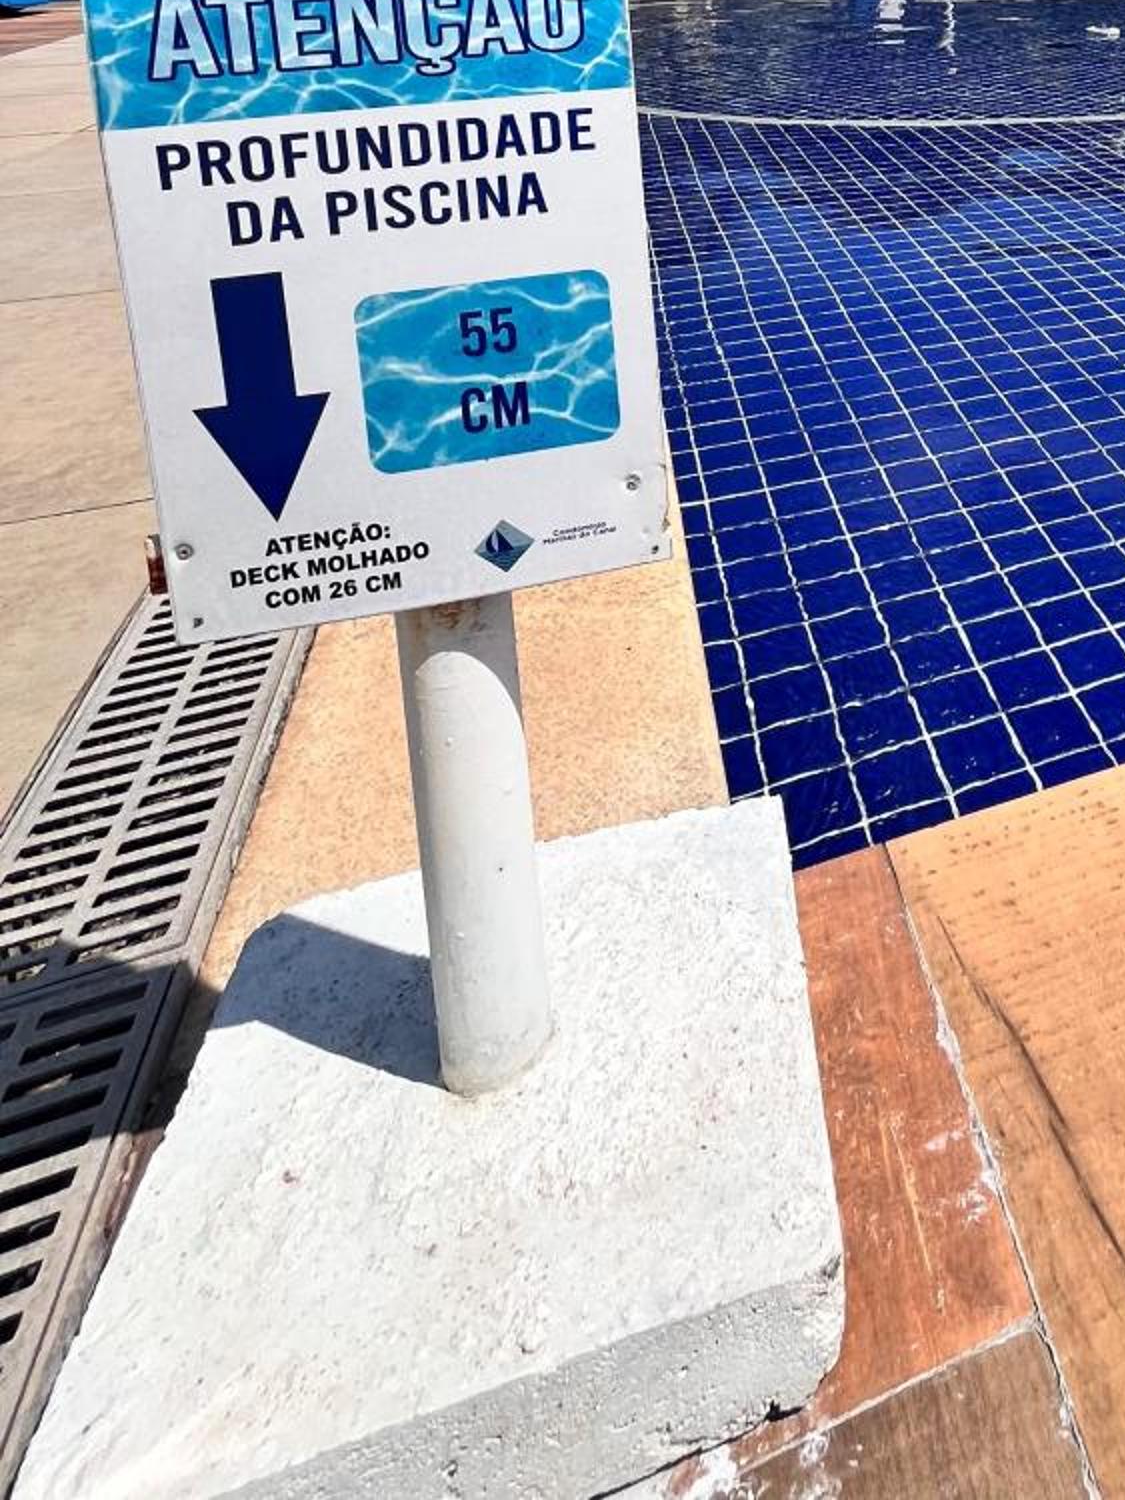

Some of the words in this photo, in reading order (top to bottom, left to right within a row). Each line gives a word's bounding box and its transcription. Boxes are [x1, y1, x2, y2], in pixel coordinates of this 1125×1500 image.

[156, 107, 596, 189] PROFUNDIDADE
[226, 199, 304, 246] DA
[327, 171, 548, 235] PISCINA
[459, 307, 517, 357] 55
[460, 381, 531, 434] CM
[230, 562, 300, 588] DECK
[307, 542, 430, 576] MOLHADO
[265, 523, 391, 557] ATENÇÃO:
[265, 586, 321, 609] COM
[329, 581, 358, 599] 26
[365, 572, 402, 594] CM
